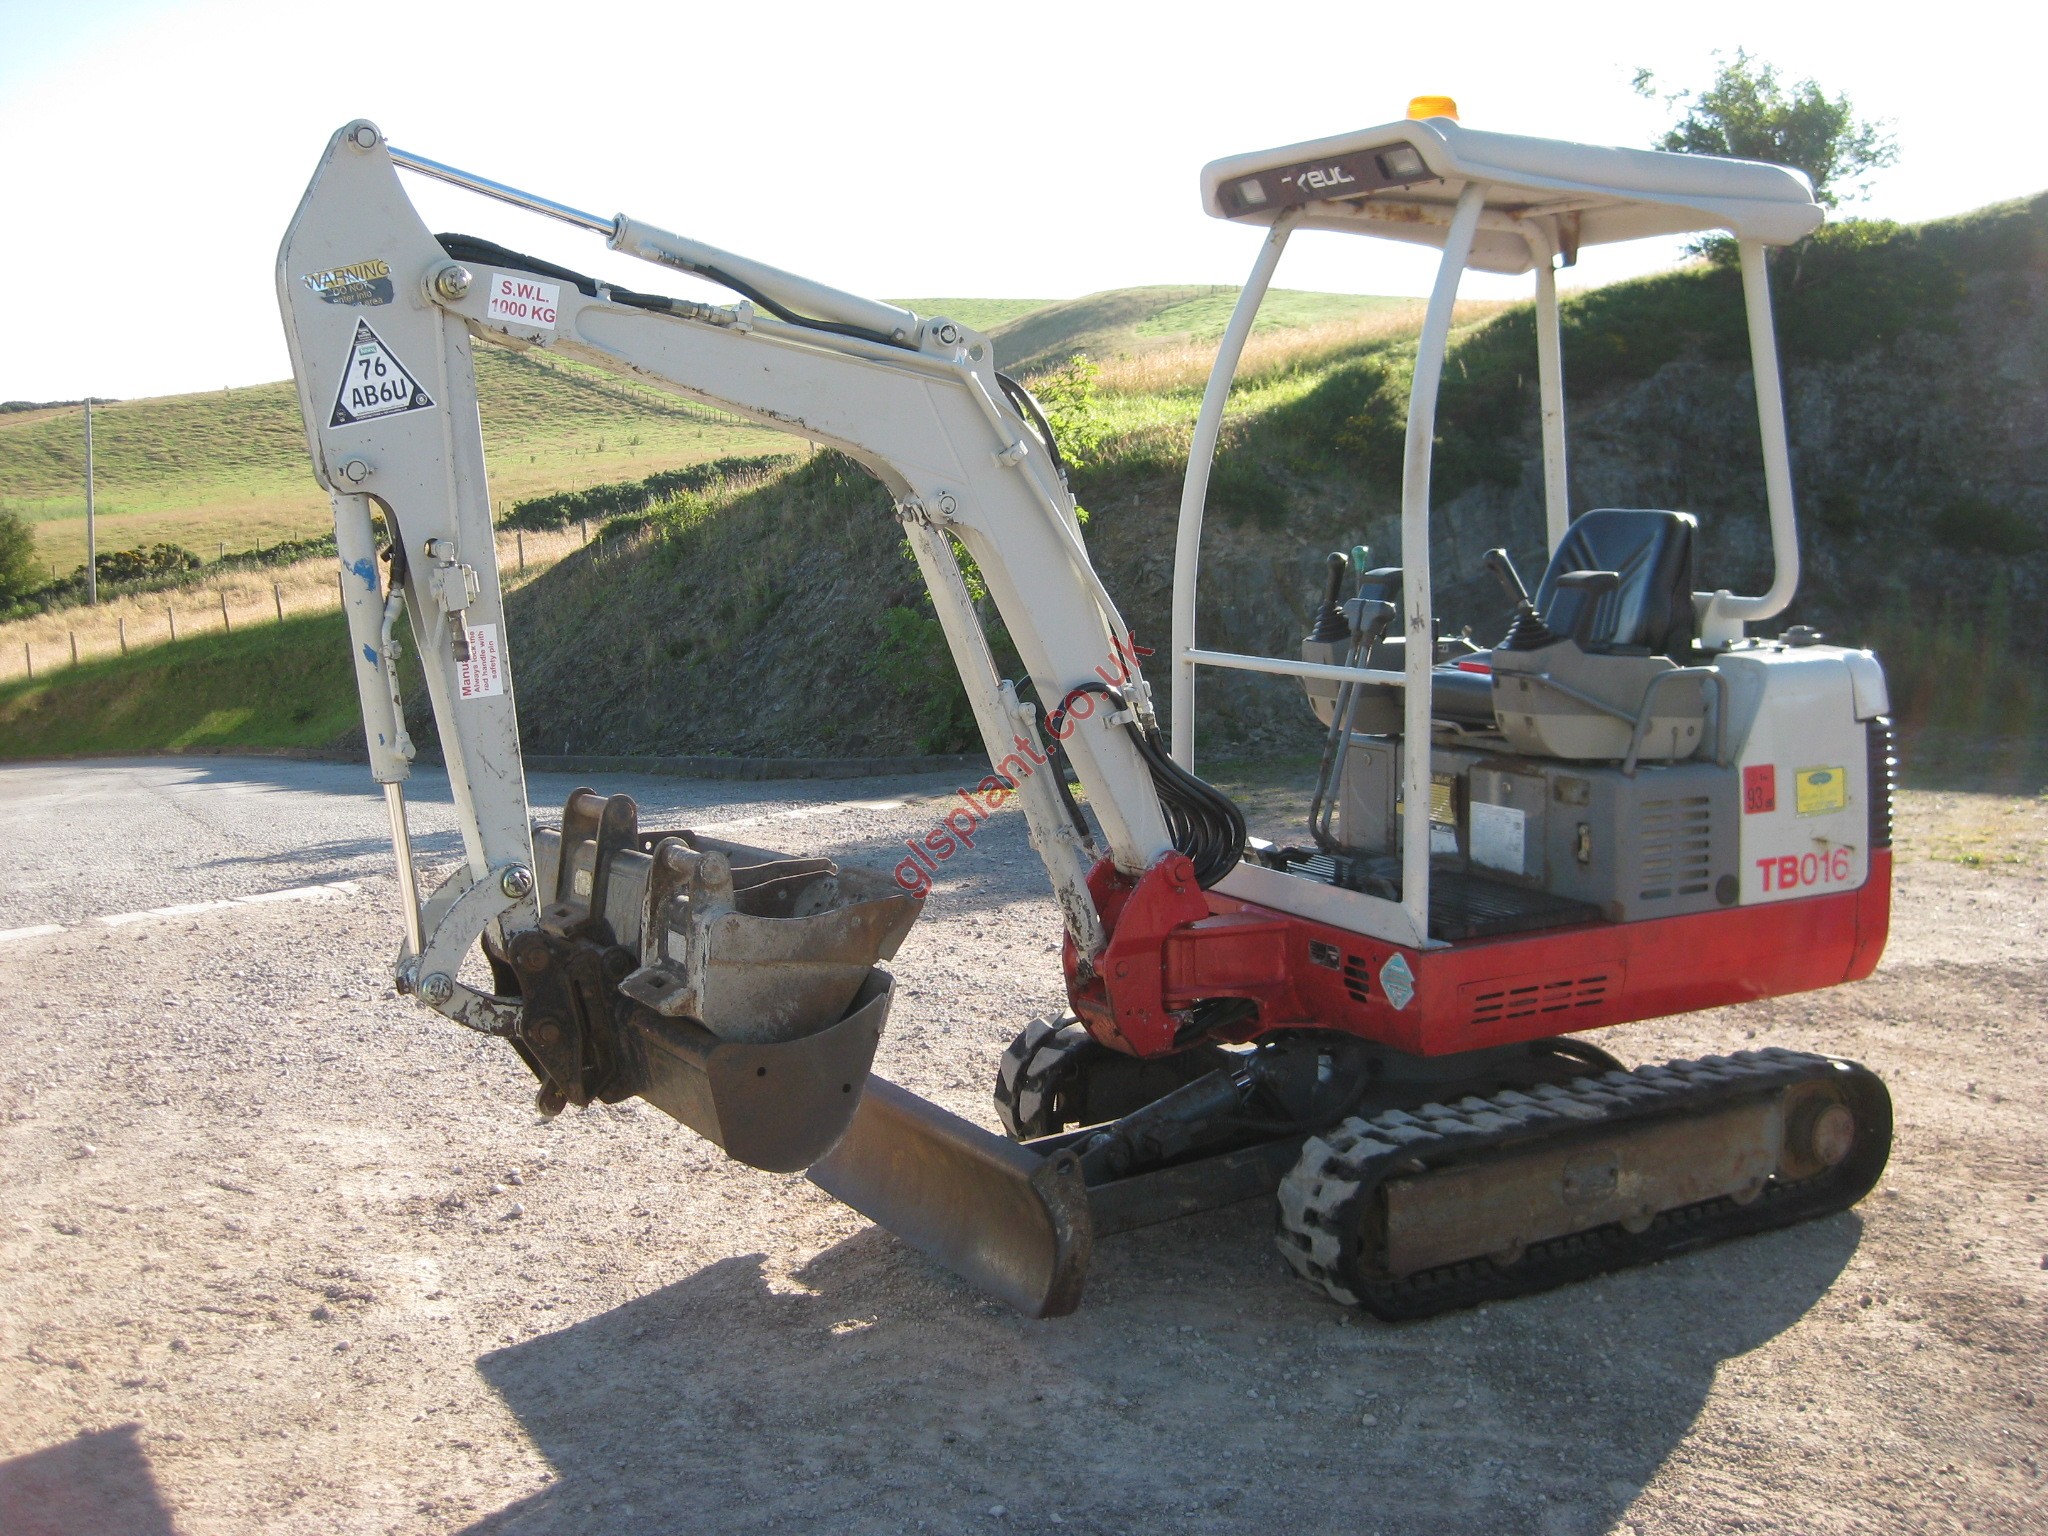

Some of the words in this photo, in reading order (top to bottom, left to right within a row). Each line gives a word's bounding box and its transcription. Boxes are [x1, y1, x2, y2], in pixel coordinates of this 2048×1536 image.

[303, 261, 391, 290] WARNING
[356, 291, 372, 300] into
[501, 280, 549, 303] S.W.L.
[491, 298, 527, 317] 1000
[531, 306, 556, 323] KG
[358, 356, 387, 380] 76
[352, 379, 408, 409] AB6U
[477, 631, 485, 647] with
[488, 640, 496, 654] pin
[480, 650, 488, 676] handle
[490, 656, 498, 679] safety
[473, 664, 481, 693] Always
[1756, 848, 1849, 892] TB016
